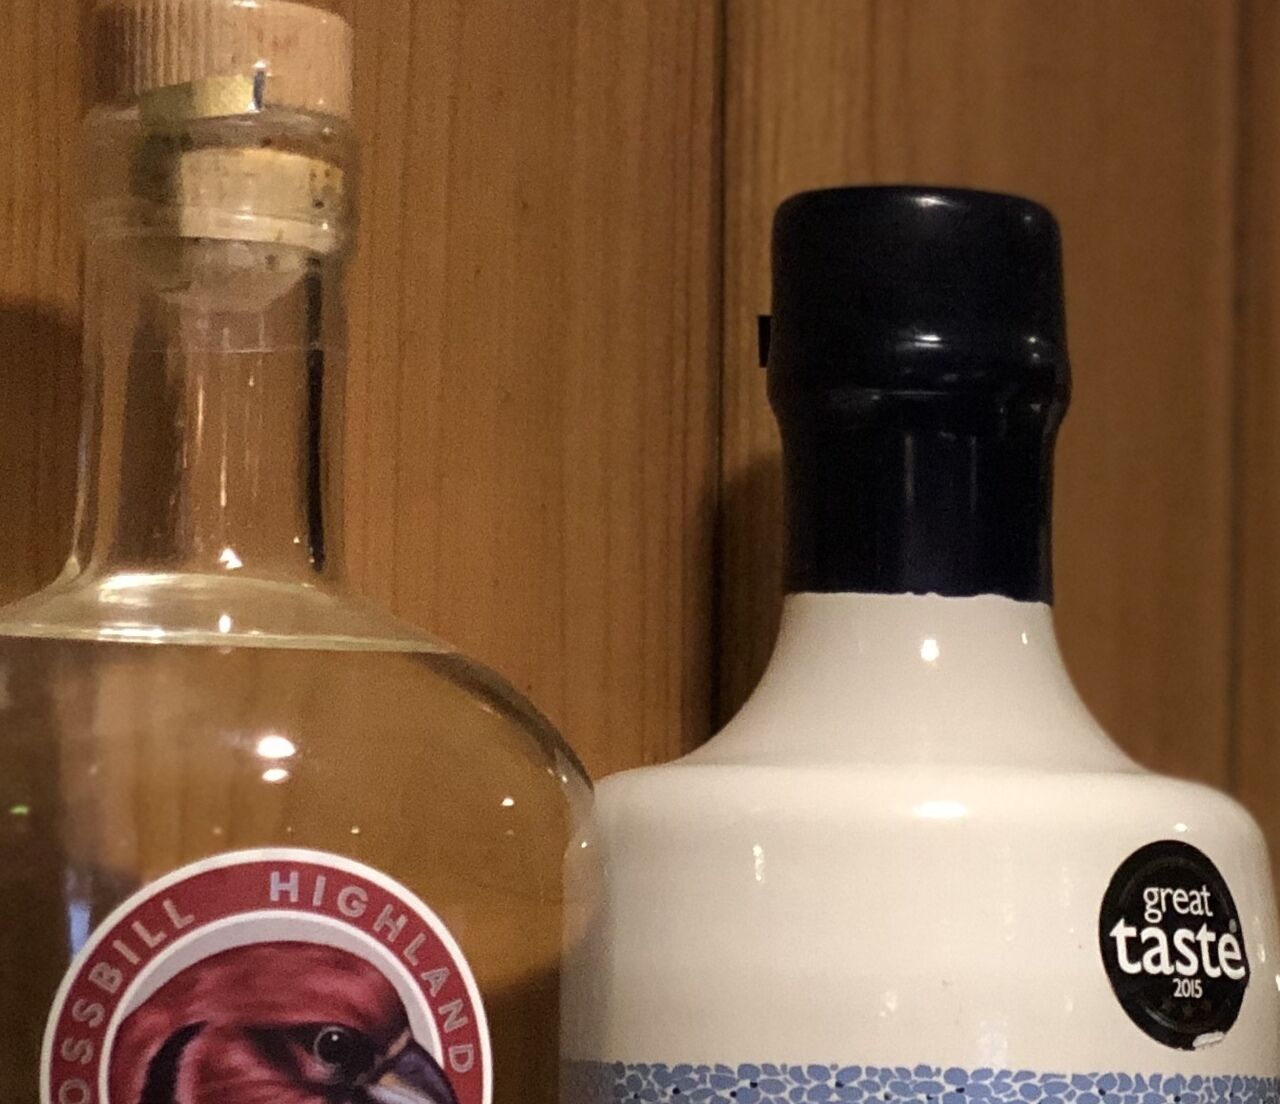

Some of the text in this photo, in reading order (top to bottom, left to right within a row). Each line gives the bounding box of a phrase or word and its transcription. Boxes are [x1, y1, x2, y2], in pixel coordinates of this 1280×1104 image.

[1143, 884, 1213, 923] great
[270, 870, 475, 1074] HIGHLAND
[1109, 917, 1246, 980] taste
[1172, 978, 1203, 998] 2015
